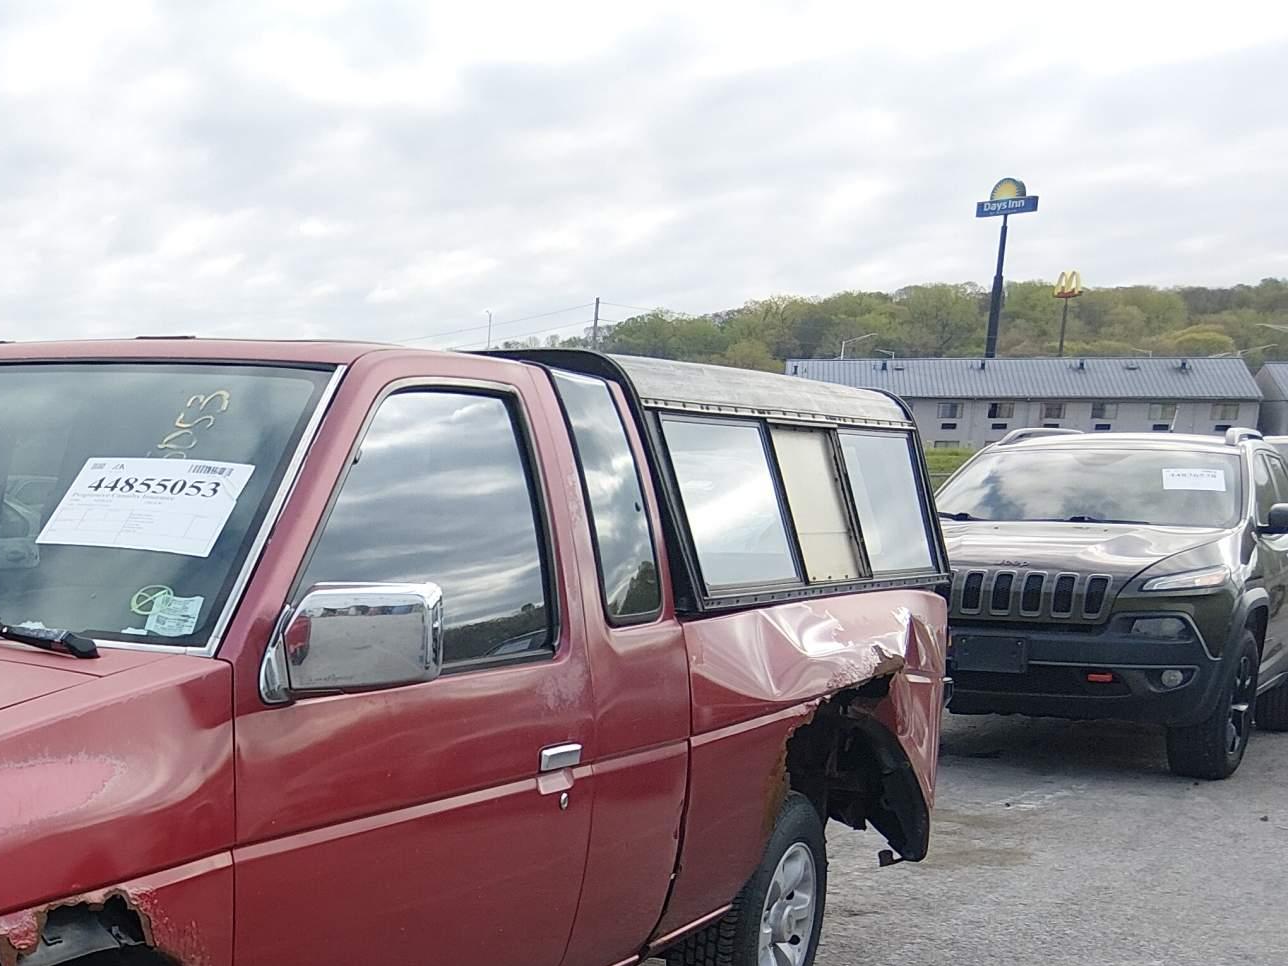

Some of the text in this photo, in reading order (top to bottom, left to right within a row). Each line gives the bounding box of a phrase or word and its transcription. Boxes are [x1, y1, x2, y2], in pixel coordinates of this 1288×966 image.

[983, 199, 1025, 212] Days Inn
[88, 476, 222, 498] 44855053
